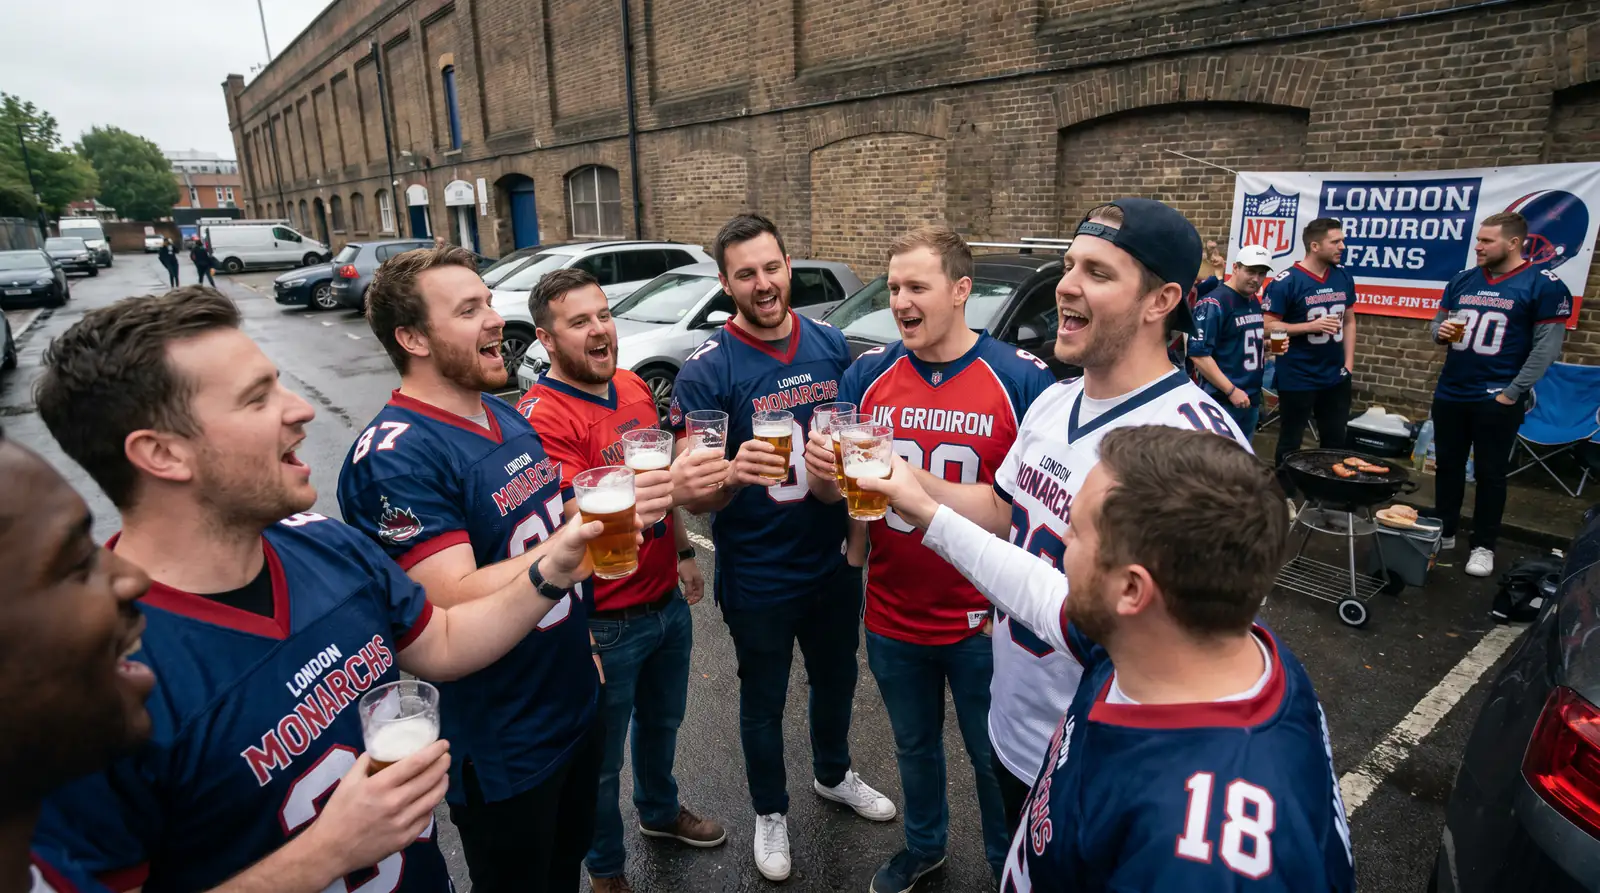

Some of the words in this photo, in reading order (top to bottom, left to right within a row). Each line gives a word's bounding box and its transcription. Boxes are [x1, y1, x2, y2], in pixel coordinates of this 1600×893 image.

[1325, 186, 1473, 211] LONDON
[1244, 218, 1289, 252] NFL
[1332, 217, 1466, 240] RIDIRON
[1344, 245, 1426, 269] FANS
[777, 373, 812, 389] LONDON
[752, 380, 838, 413] MONARCHS
[872, 405, 896, 428] UK
[901, 407, 994, 437] GRIDIRON
[504, 453, 533, 476] LONDON
[1039, 455, 1072, 483] LONDON
[286, 643, 342, 698] LONDON
[240, 634, 394, 787] MONARCHS
[1174, 771, 1276, 880] 18
